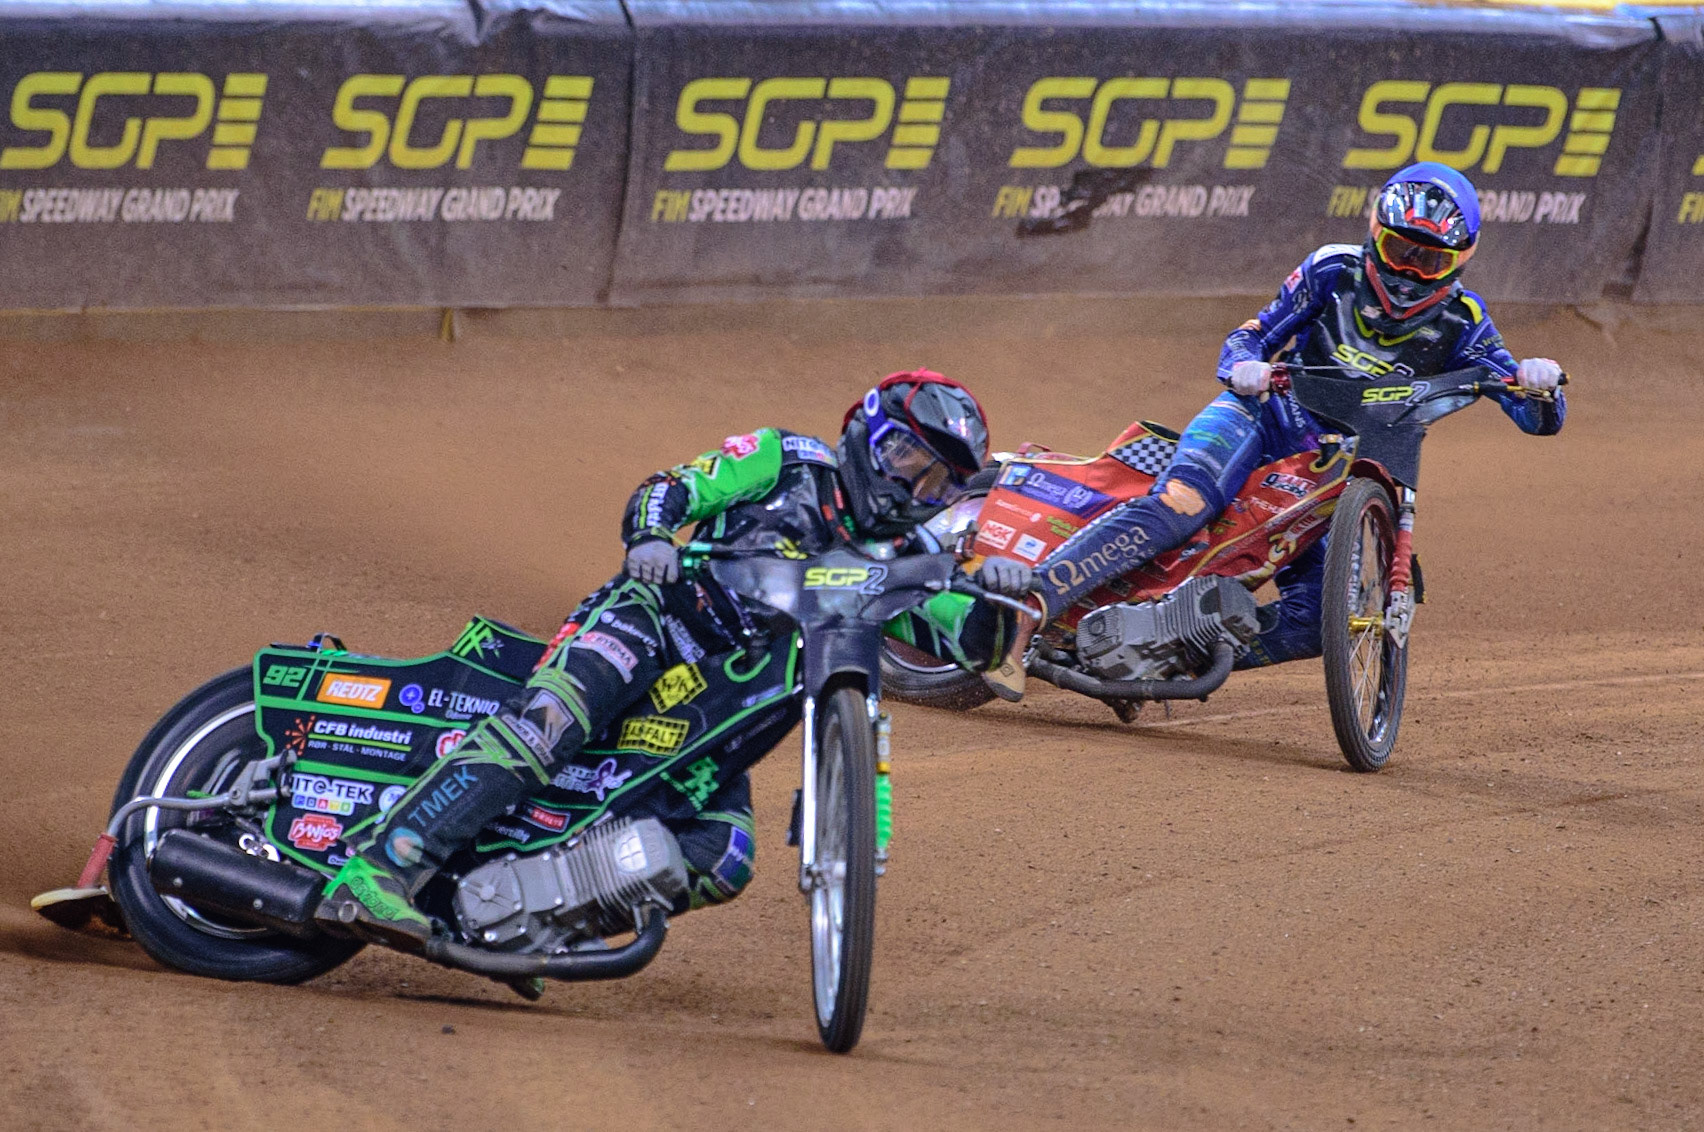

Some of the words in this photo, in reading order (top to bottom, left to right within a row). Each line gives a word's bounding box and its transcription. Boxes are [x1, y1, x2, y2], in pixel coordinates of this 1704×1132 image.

[0, 72, 215, 169] SGP
[320, 74, 534, 170] SGP
[664, 77, 896, 171] SGP
[1009, 77, 1235, 168] SGP
[1342, 80, 1568, 174] SGP
[20, 187, 125, 223] SPEEDWAY
[121, 187, 191, 223] GRAND
[188, 187, 240, 223] PRIX
[306, 187, 345, 222] FIM
[342, 187, 445, 222] SPEEDWAY
[440, 187, 507, 221] GRAND
[505, 187, 562, 221] PRIX
[651, 188, 691, 223] FIM
[689, 187, 799, 222] SPEEDWAY
[797, 187, 868, 221] GRAND
[867, 187, 918, 220] PRIX
[992, 185, 1033, 218] FIM
[1134, 184, 1208, 217] GRAND
[1206, 184, 1256, 217] PRIX
[1328, 186, 1367, 218] FIM
[1480, 190, 1537, 223] RAND
[1534, 191, 1587, 224] PRIX
[803, 563, 889, 595] SGP2
[263, 665, 307, 688] 92
[314, 720, 348, 736] CFB
[348, 722, 412, 745] industri
[361, 747, 407, 762] MONTAGE
